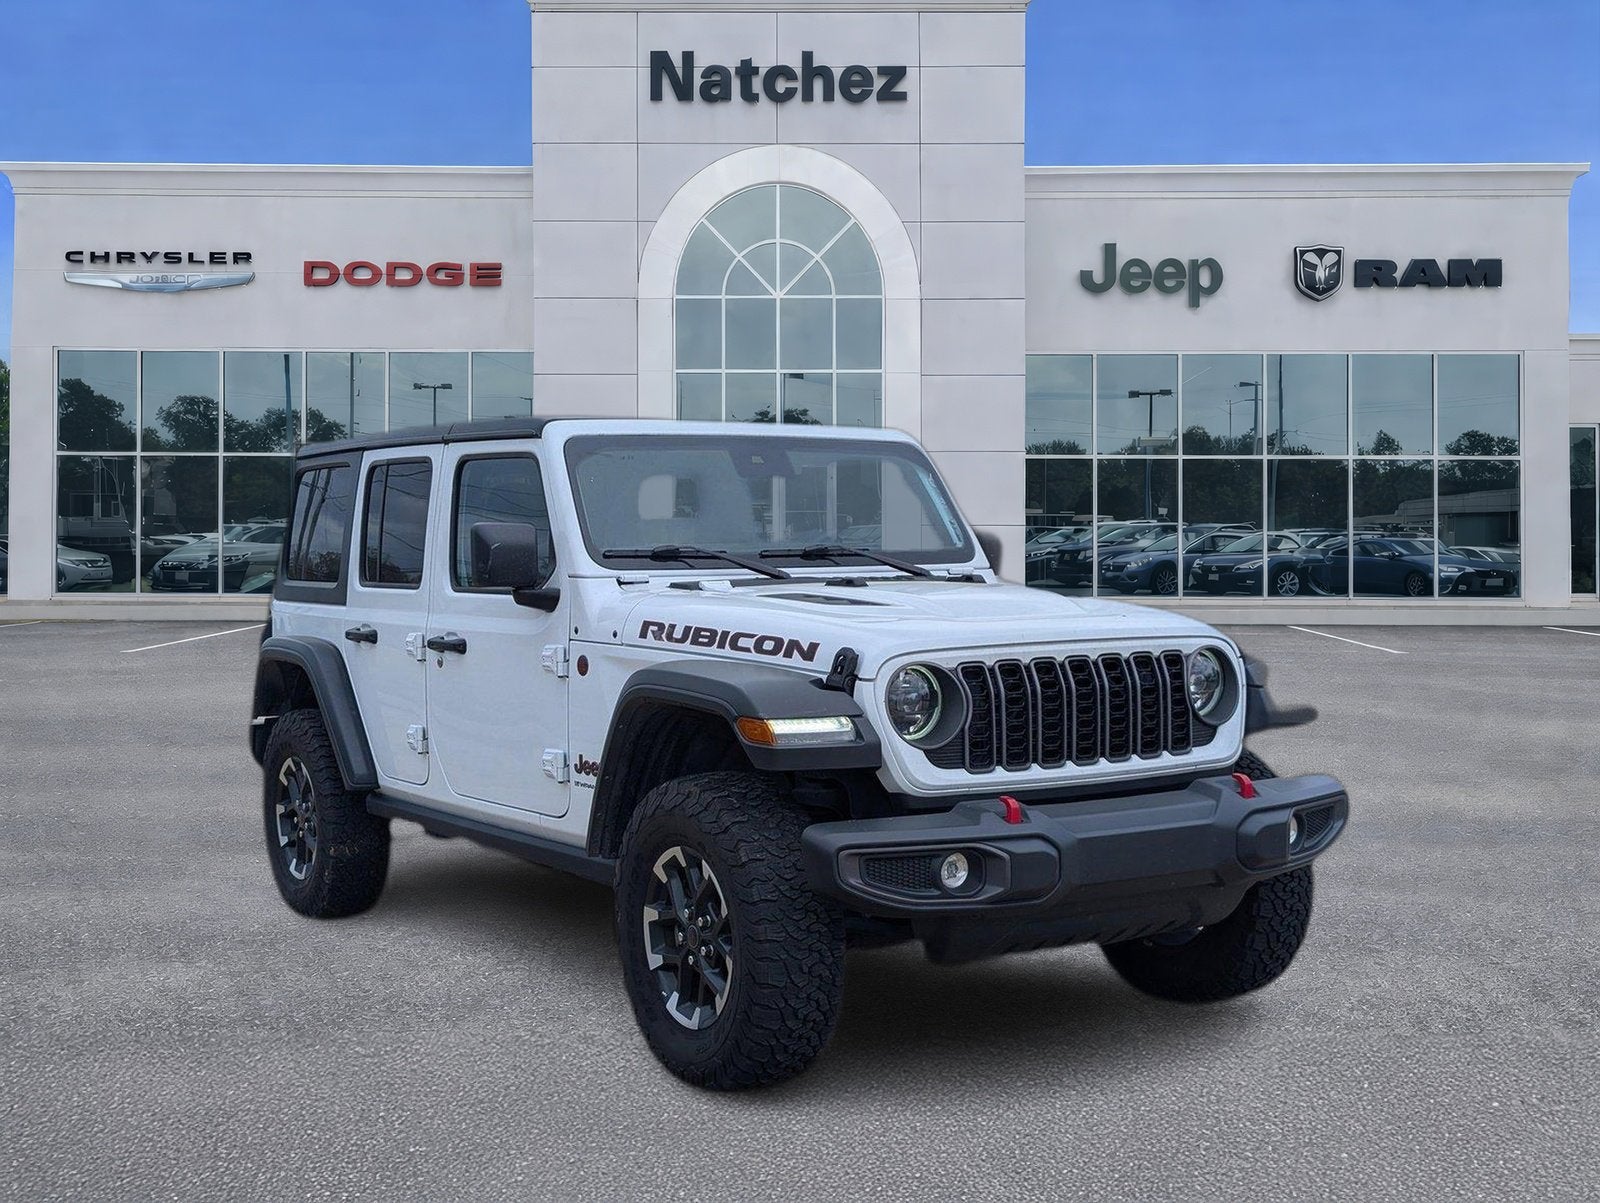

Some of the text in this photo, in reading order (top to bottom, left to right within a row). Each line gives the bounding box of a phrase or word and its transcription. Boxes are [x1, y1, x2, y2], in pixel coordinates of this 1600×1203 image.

[649, 50, 908, 104] Natchez
[64, 250, 253, 265] CHRYSLER
[303, 260, 503, 287] DODGE
[1353, 257, 1503, 289] RAM
[1079, 242, 1224, 310] Jeep
[638, 619, 820, 662] RUBICON
[573, 753, 602, 778] Jee
